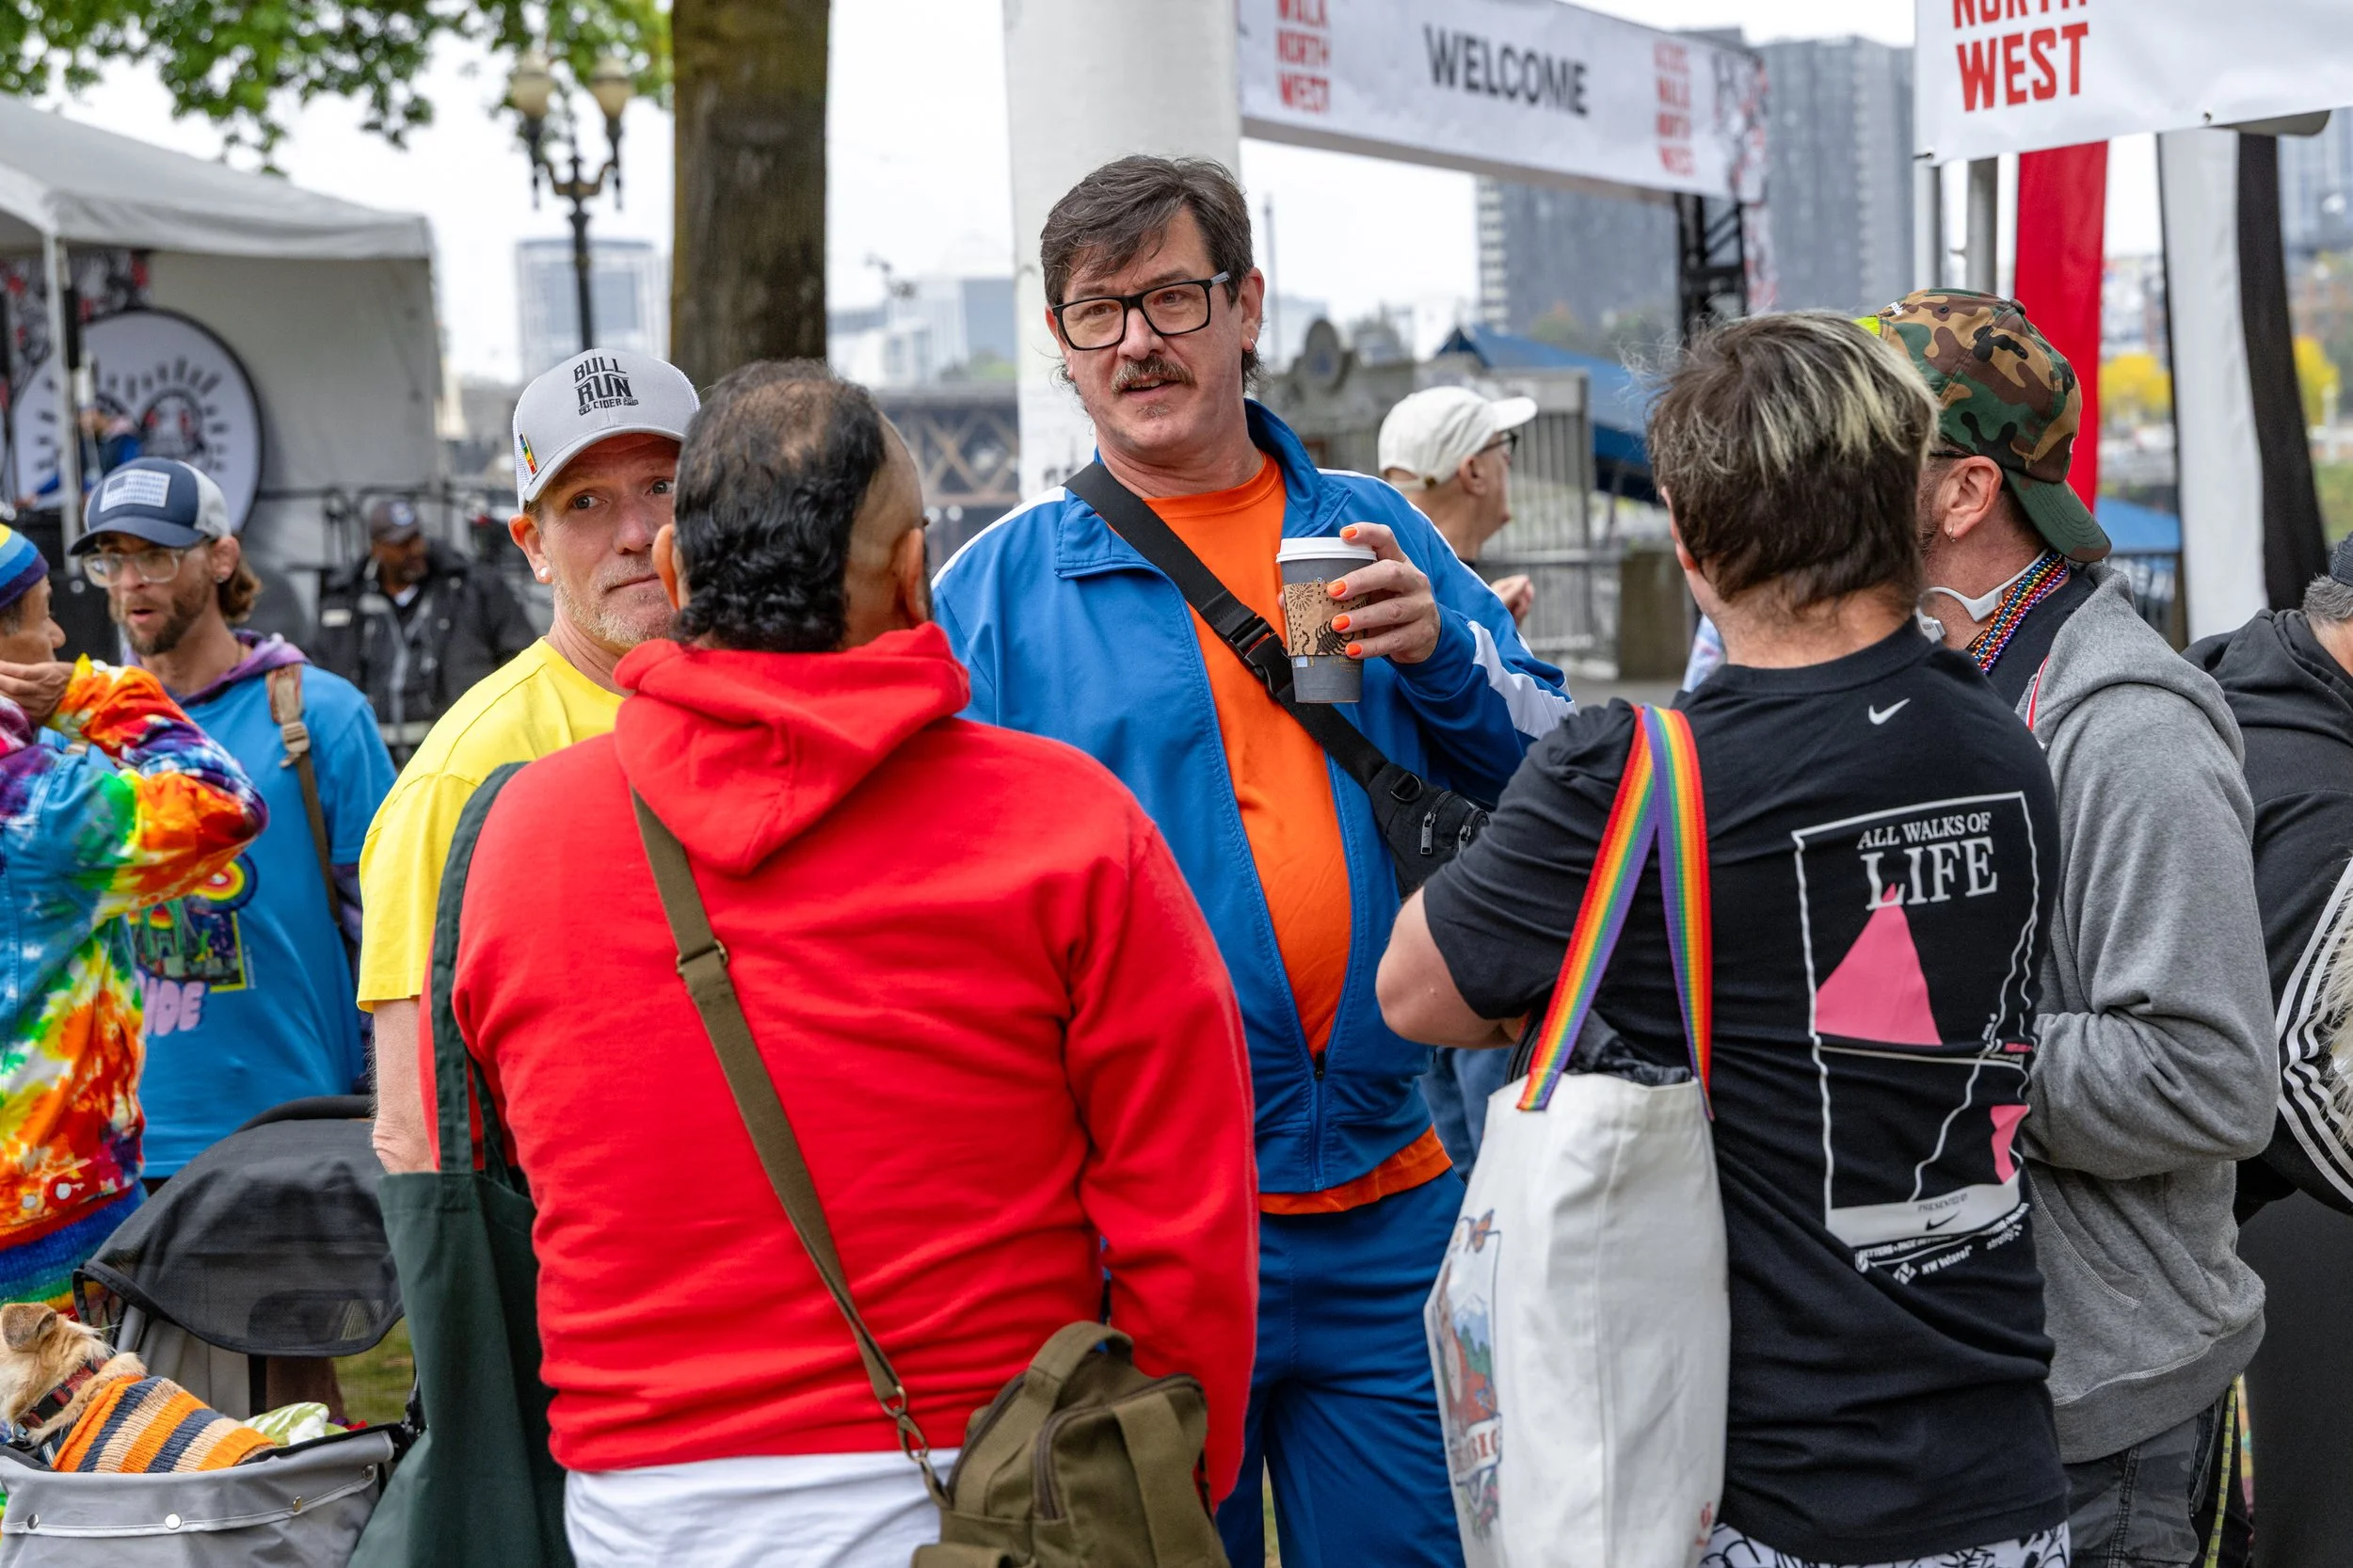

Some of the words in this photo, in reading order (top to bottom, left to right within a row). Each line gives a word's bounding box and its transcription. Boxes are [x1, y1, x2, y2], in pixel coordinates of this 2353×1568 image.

[1422, 22, 1590, 119] WELCOME
[1956, 21, 2089, 113] WEST
[573, 356, 627, 384] BULL
[577, 374, 633, 408] RUN
[593, 398, 622, 409] CIDER
[1857, 825, 1900, 850] ALL
[1901, 814, 1966, 843] WALKS
[1966, 811, 1992, 834] OF
[1860, 836, 1998, 911] LIFE
